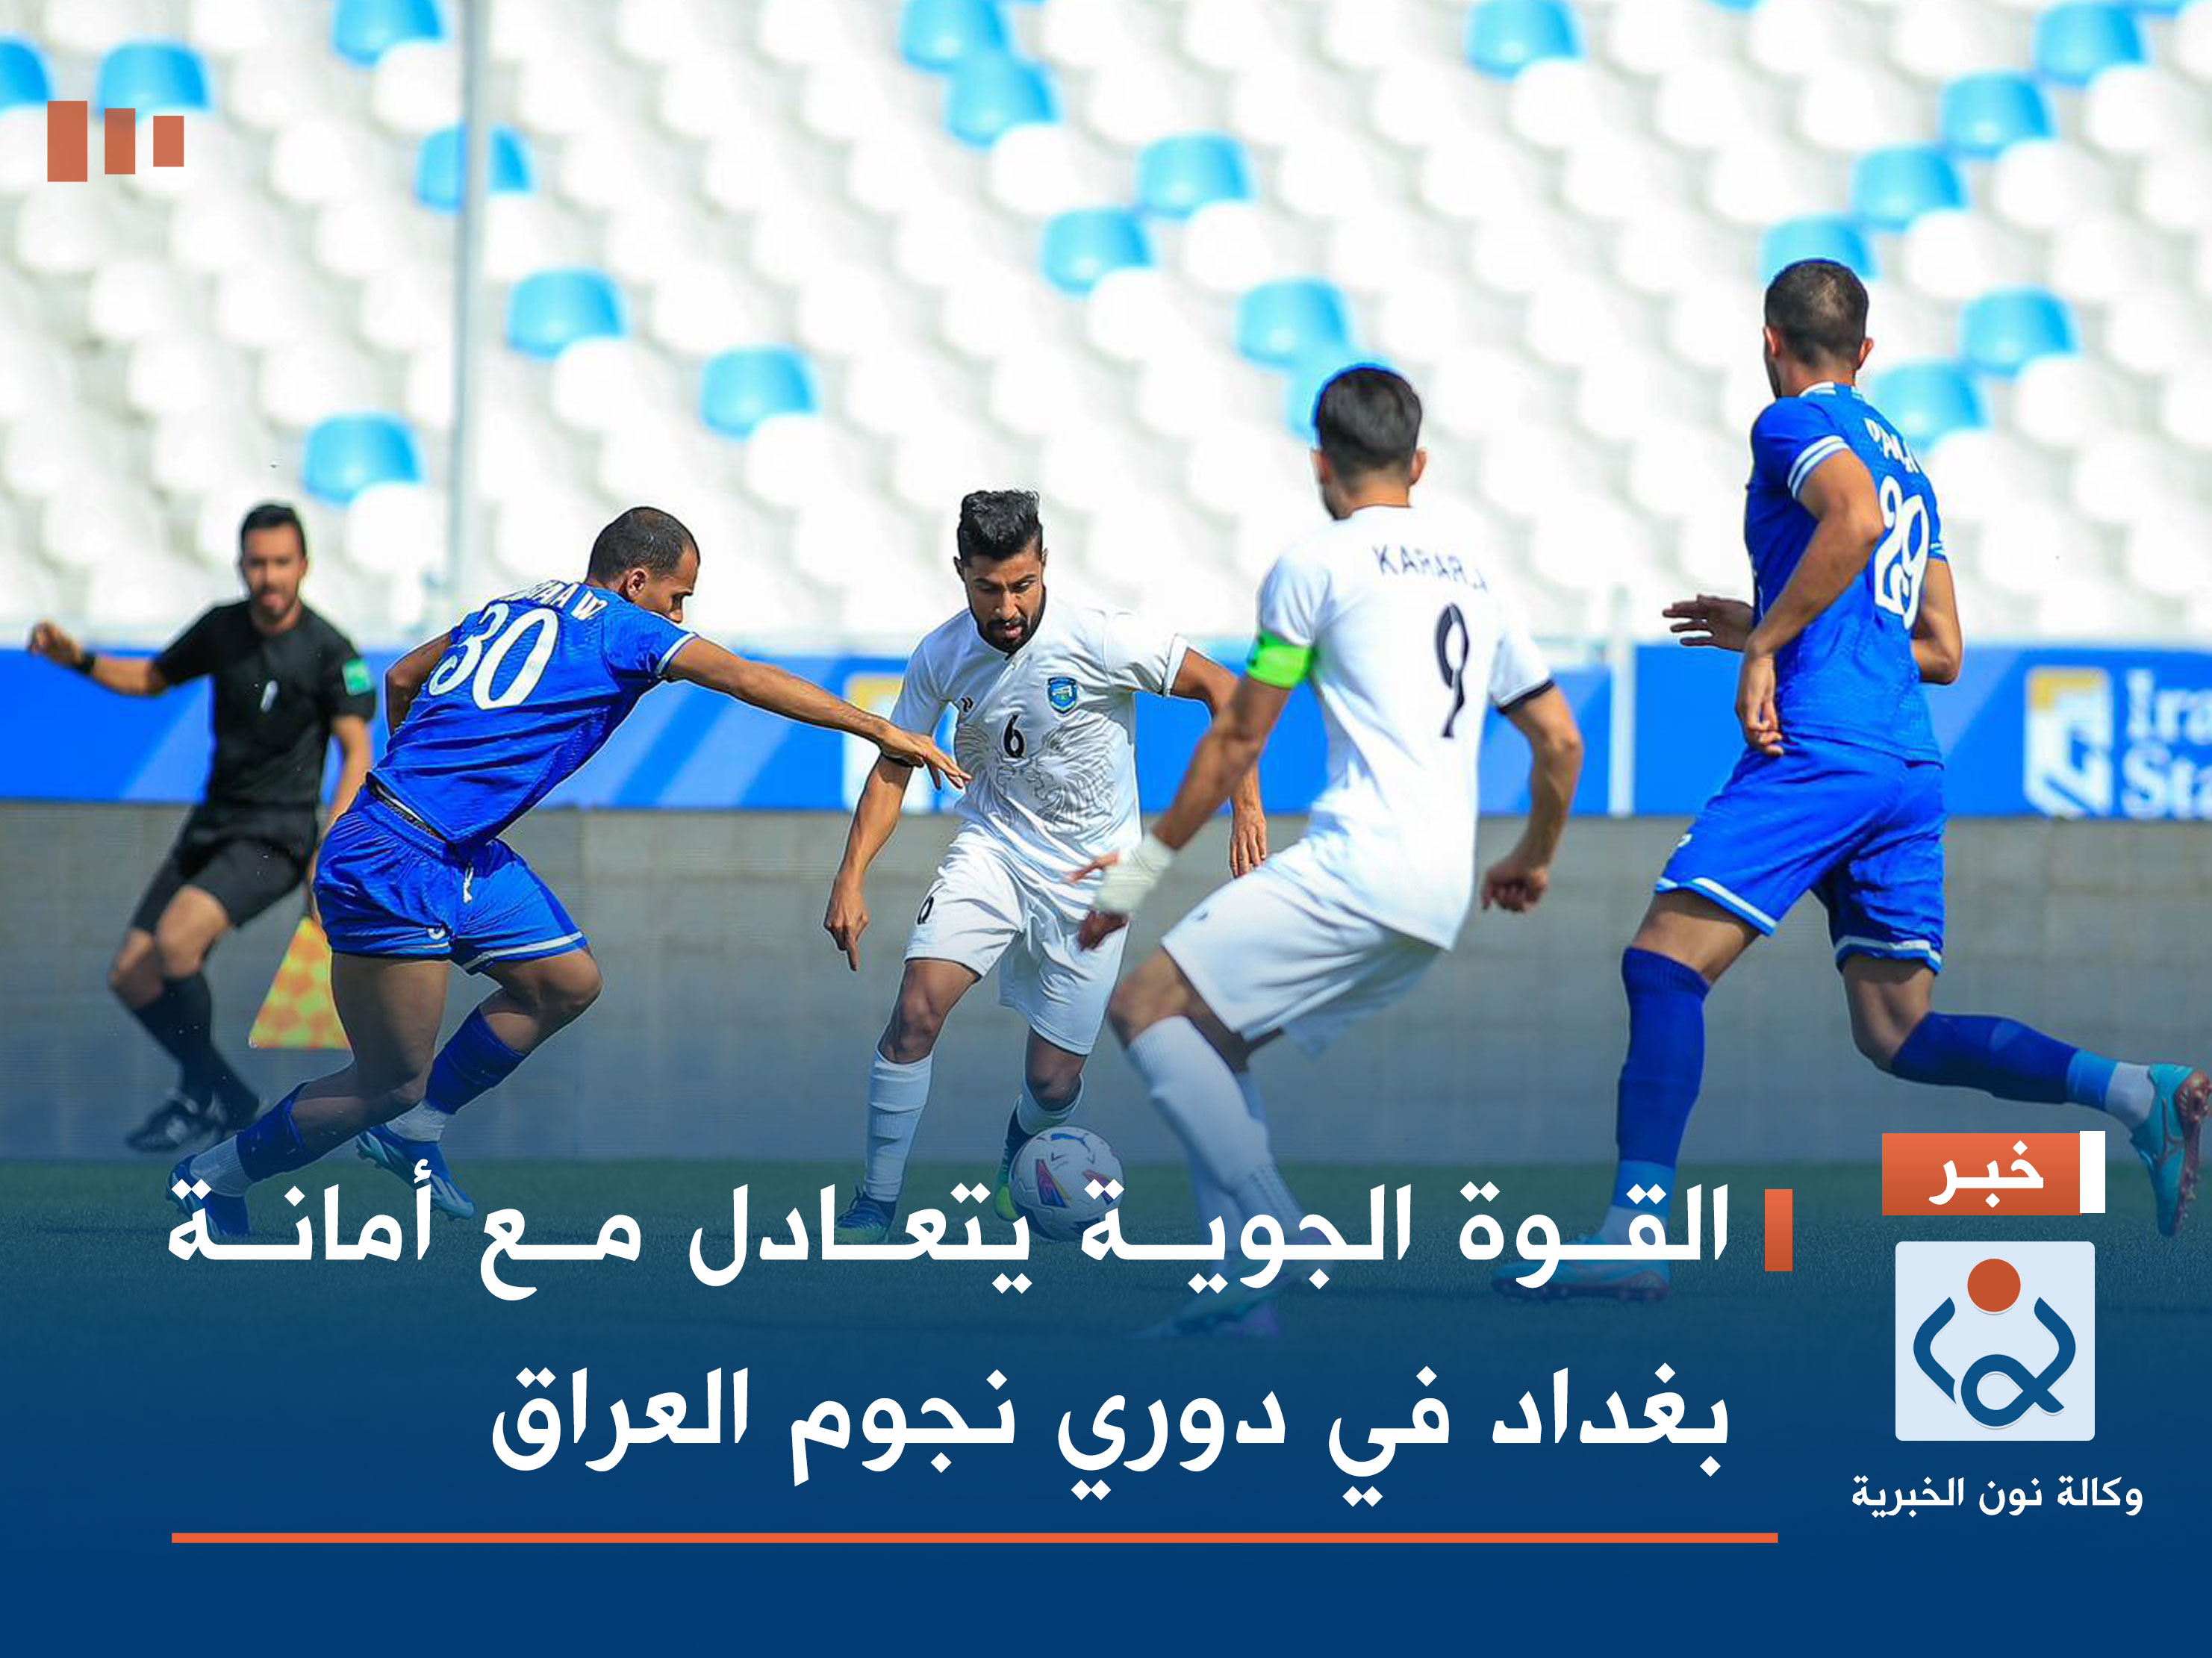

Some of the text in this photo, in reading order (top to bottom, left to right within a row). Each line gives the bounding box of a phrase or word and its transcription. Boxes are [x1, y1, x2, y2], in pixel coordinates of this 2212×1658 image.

[1873, 475, 1931, 630] 29
[428, 602, 559, 710] 30
[1434, 602, 1470, 739] 9
[1003, 714, 1026, 759] 6
